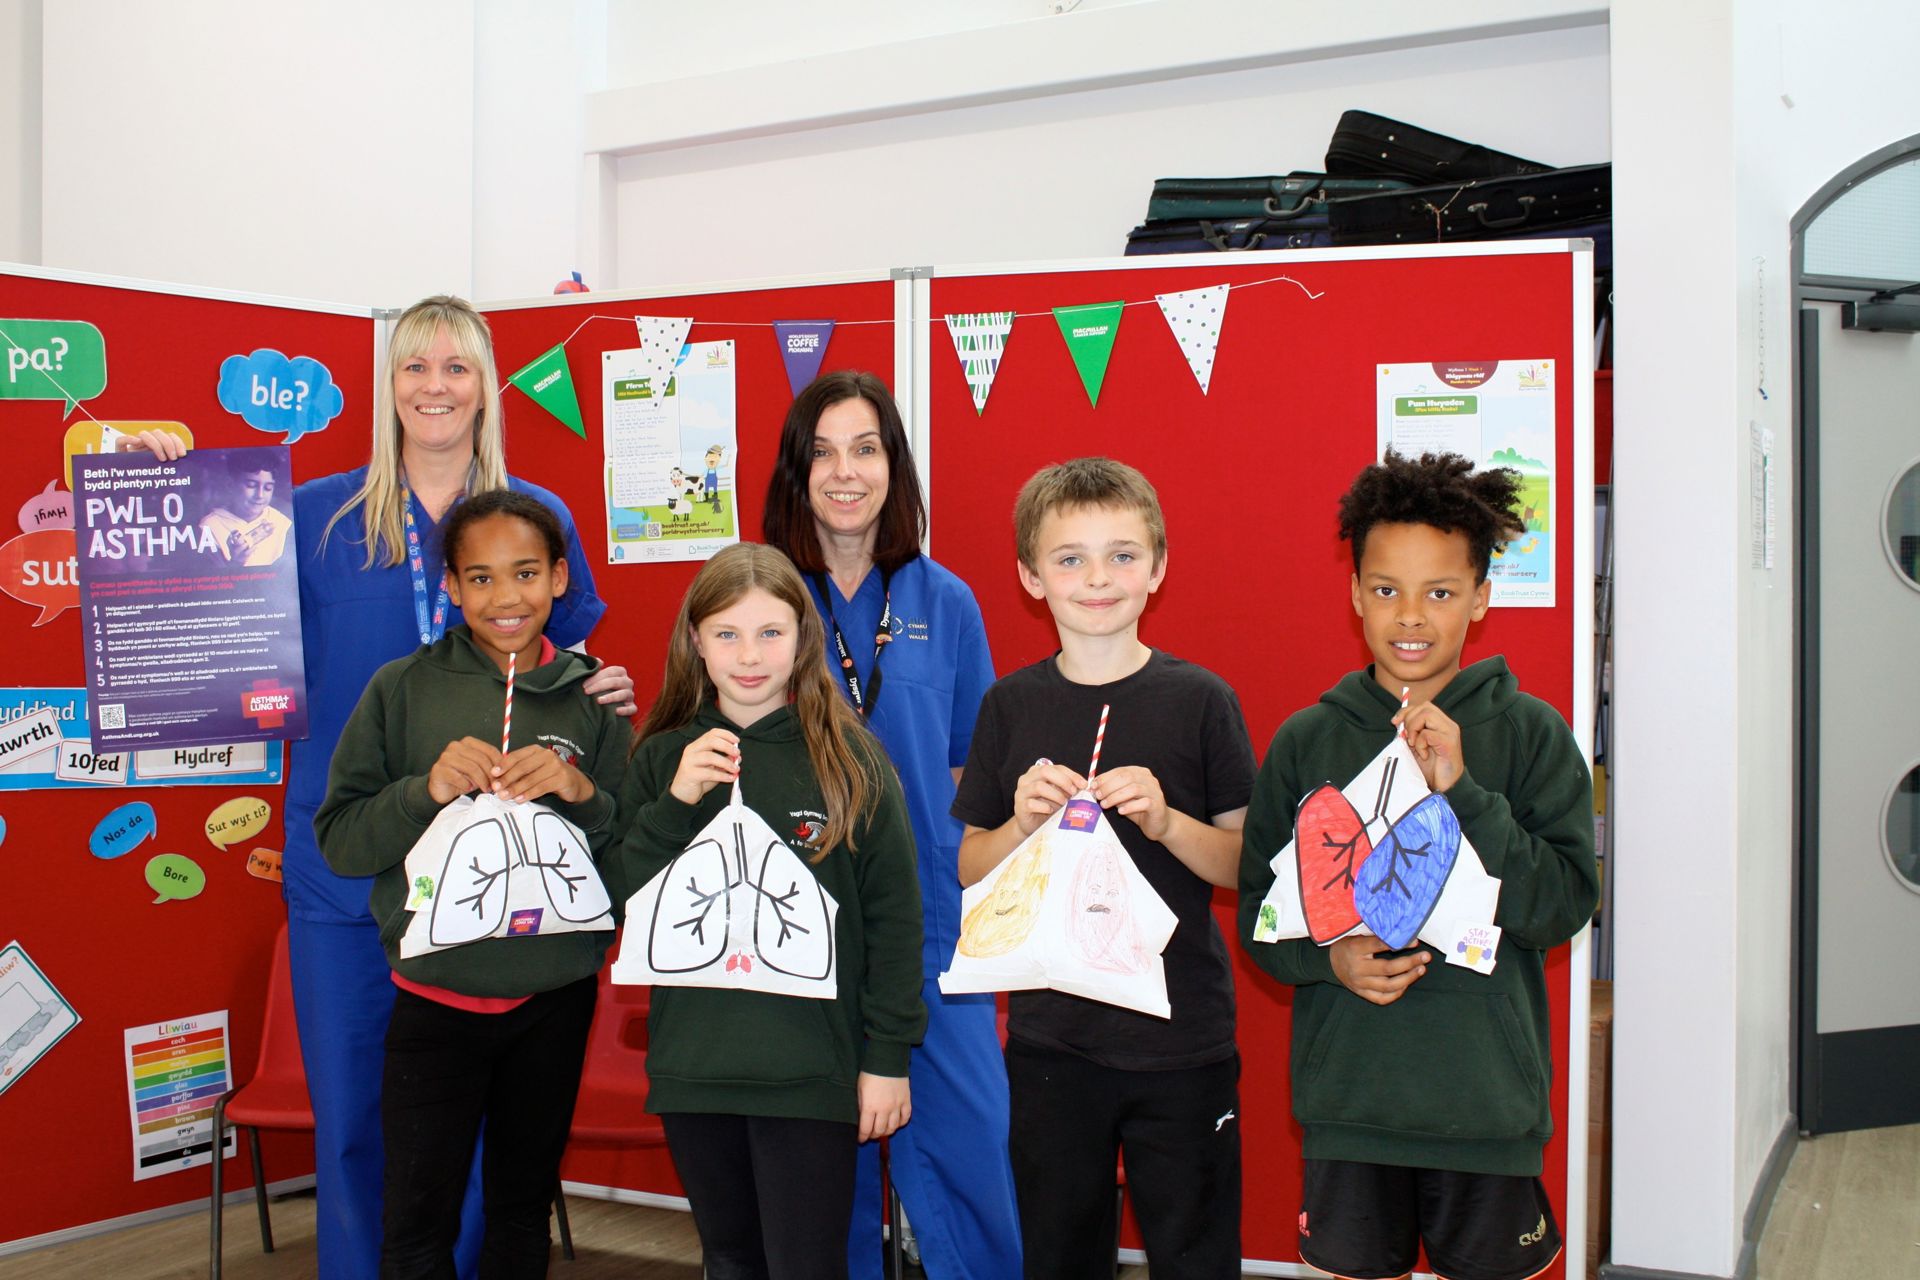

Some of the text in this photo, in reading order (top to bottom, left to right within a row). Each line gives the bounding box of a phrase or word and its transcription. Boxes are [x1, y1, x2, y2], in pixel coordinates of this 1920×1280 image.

[1072, 325, 1109, 333] MACMILLAN
[787, 338, 819, 348] COFFEE
[8, 337, 69, 383] pa?
[251, 374, 309, 412] ble?
[1426, 399, 1465, 408] Hwyaden
[84, 466, 176, 479] Beth i'w wneud os
[84, 476, 190, 492] bydd plentyn yn cael
[86, 493, 184, 528] PWL O
[88, 525, 218, 560] ASTHMA
[22, 556, 80, 586] sut
[92, 605, 98, 617] 1
[93, 622, 102, 635] 2
[94, 639, 103, 652] 3
[96, 656, 103, 669] 4
[97, 674, 105, 686] 5
[849, 677, 862, 704] Dysgwr
[250, 694, 290, 704] ASTHMA+
[250, 702, 288, 712] LUNG UK
[68, 752, 120, 775] 10fed
[174, 746, 234, 768] Hydref
[208, 806, 266, 834] Sut wyt ti?
[104, 816, 144, 845] Nos da
[250, 854, 272, 872] Pwy
[163, 866, 189, 884] Bore
[1468, 928, 1490, 938] STAY
[158, 1021, 197, 1036] Lliwiau
[171, 1036, 186, 1045] coch
[168, 1068, 192, 1081] gwyrdd
[171, 1092, 193, 1104] porffor
[178, 1126, 195, 1136] gwyn
